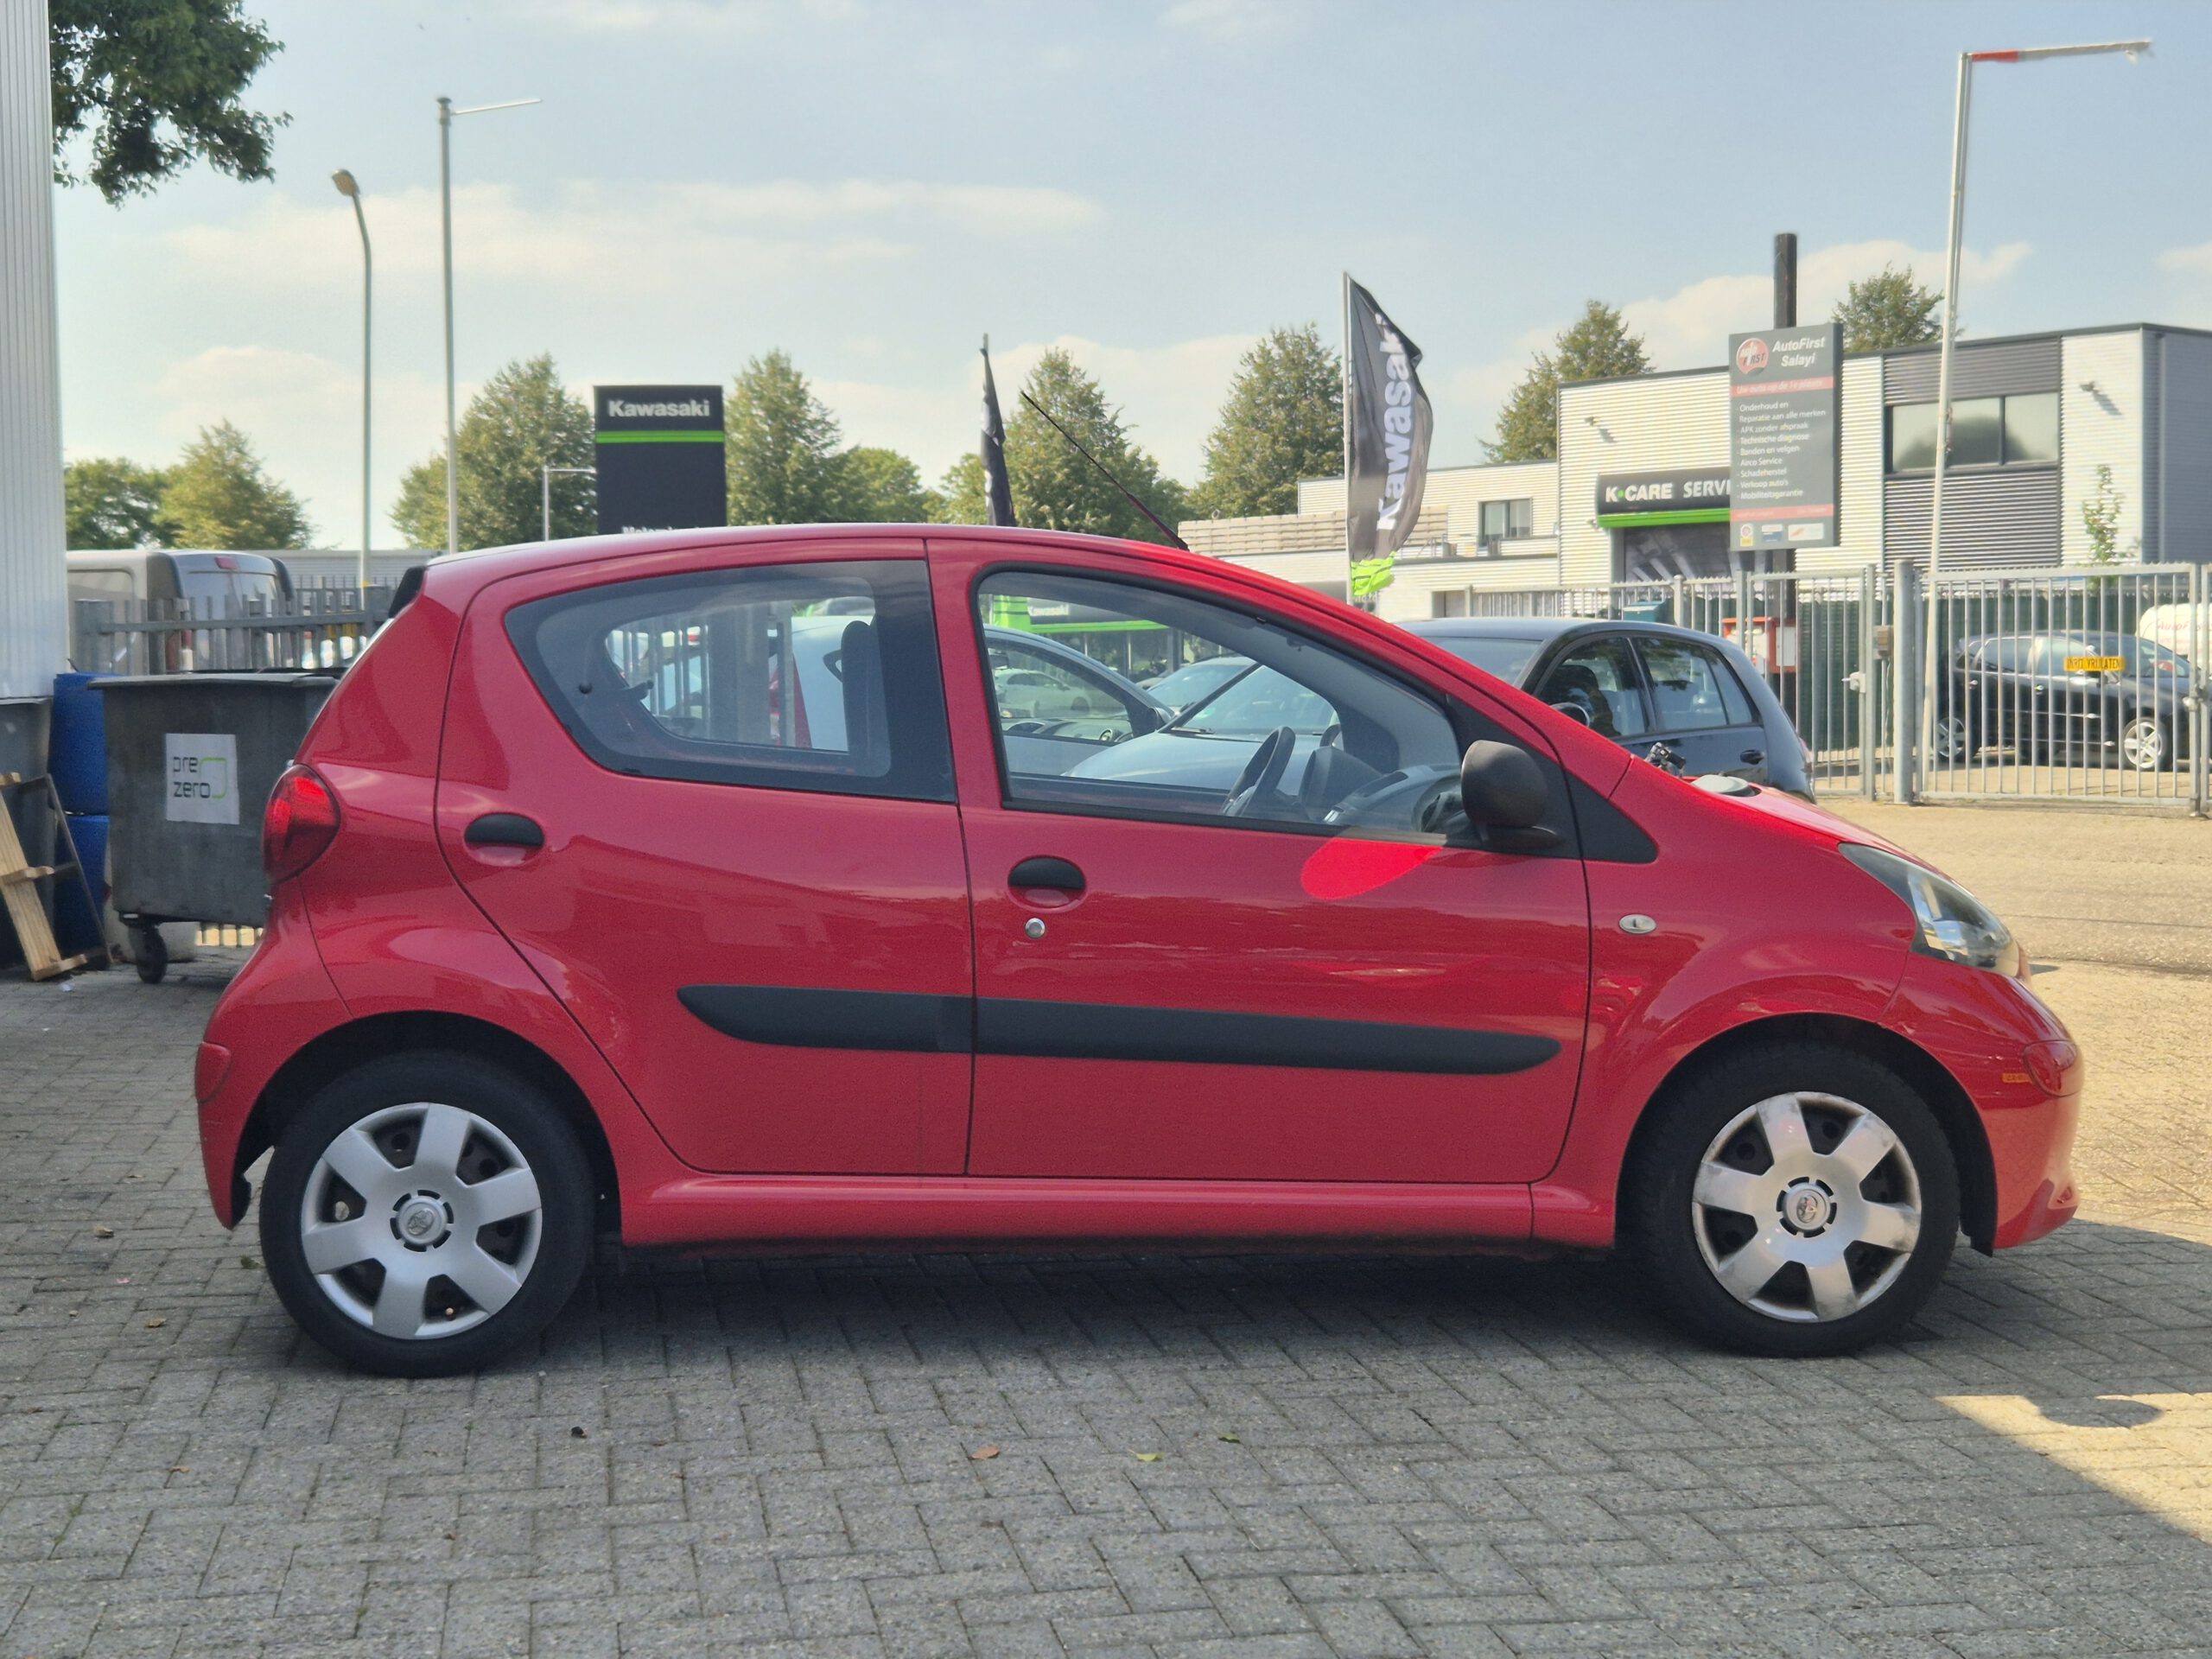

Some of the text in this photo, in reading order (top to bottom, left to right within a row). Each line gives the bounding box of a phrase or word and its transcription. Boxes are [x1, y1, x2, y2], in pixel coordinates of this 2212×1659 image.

[1772, 336, 1826, 353] AutoFirst
[608, 399, 710, 417] Kawasaki
[1739, 402, 1778, 412] Onderhoud
[1739, 415, 1770, 423] Reparatie
[1755, 424, 1778, 433] zonder
[1779, 422, 1808, 431] afspraak
[1740, 434, 1810, 445] Technische diagnose
[1740, 448, 1765, 456] Banden
[1776, 445, 1800, 454] velgen
[1740, 457, 1783, 467] Airco Service
[1740, 467, 1788, 478] Schadeherstel
[1740, 480, 1768, 489] Verkoop
[174, 781, 211, 798] zero
